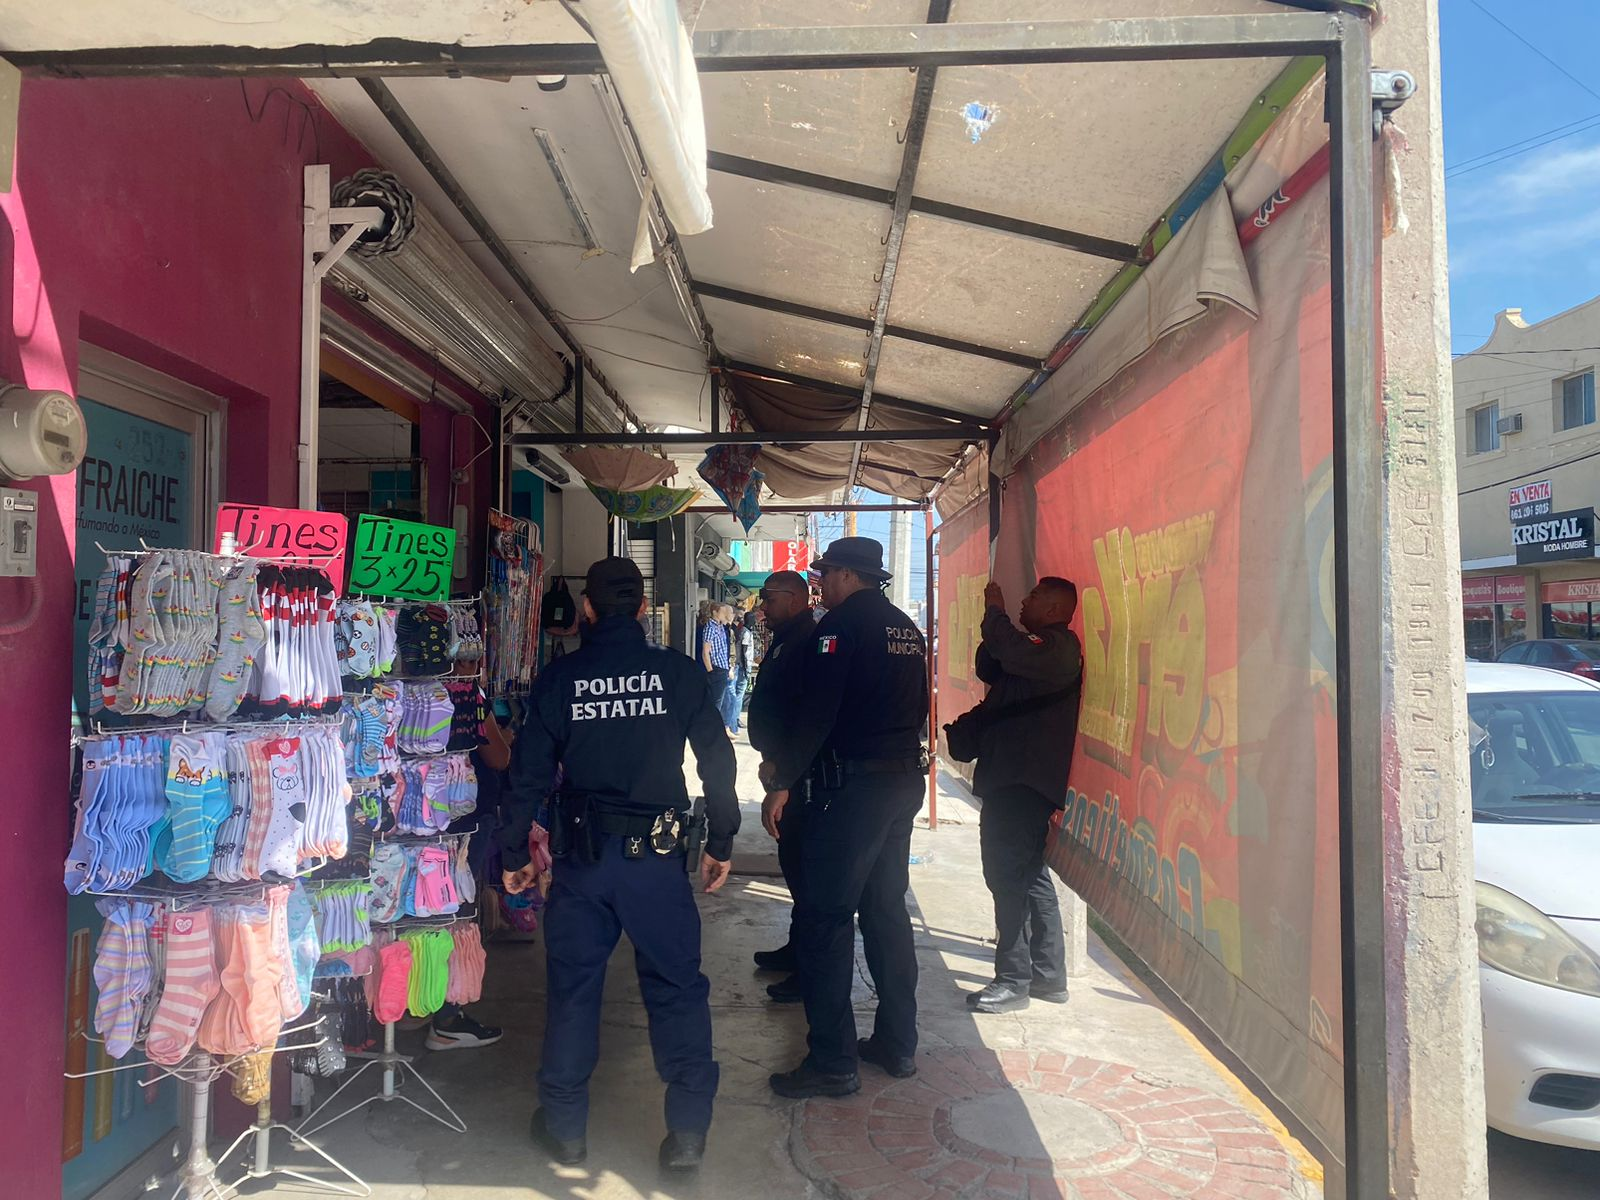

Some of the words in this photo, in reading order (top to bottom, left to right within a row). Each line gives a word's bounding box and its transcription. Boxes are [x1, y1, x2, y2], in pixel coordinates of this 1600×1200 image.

[79, 455, 179, 524] FRAICHE
[1509, 489, 1520, 504] EN
[1523, 483, 1549, 502] VENTA
[222, 505, 339, 552] Tines
[361, 518, 449, 558] Tines
[1511, 517, 1583, 546] KRISTAL
[1543, 543, 1561, 553] MODA
[1562, 540, 1588, 551] HOMBRE
[887, 642, 924, 656] MUNICIPAL
[573, 670, 664, 698] POLICÍA
[570, 697, 667, 721] ESTATAL
